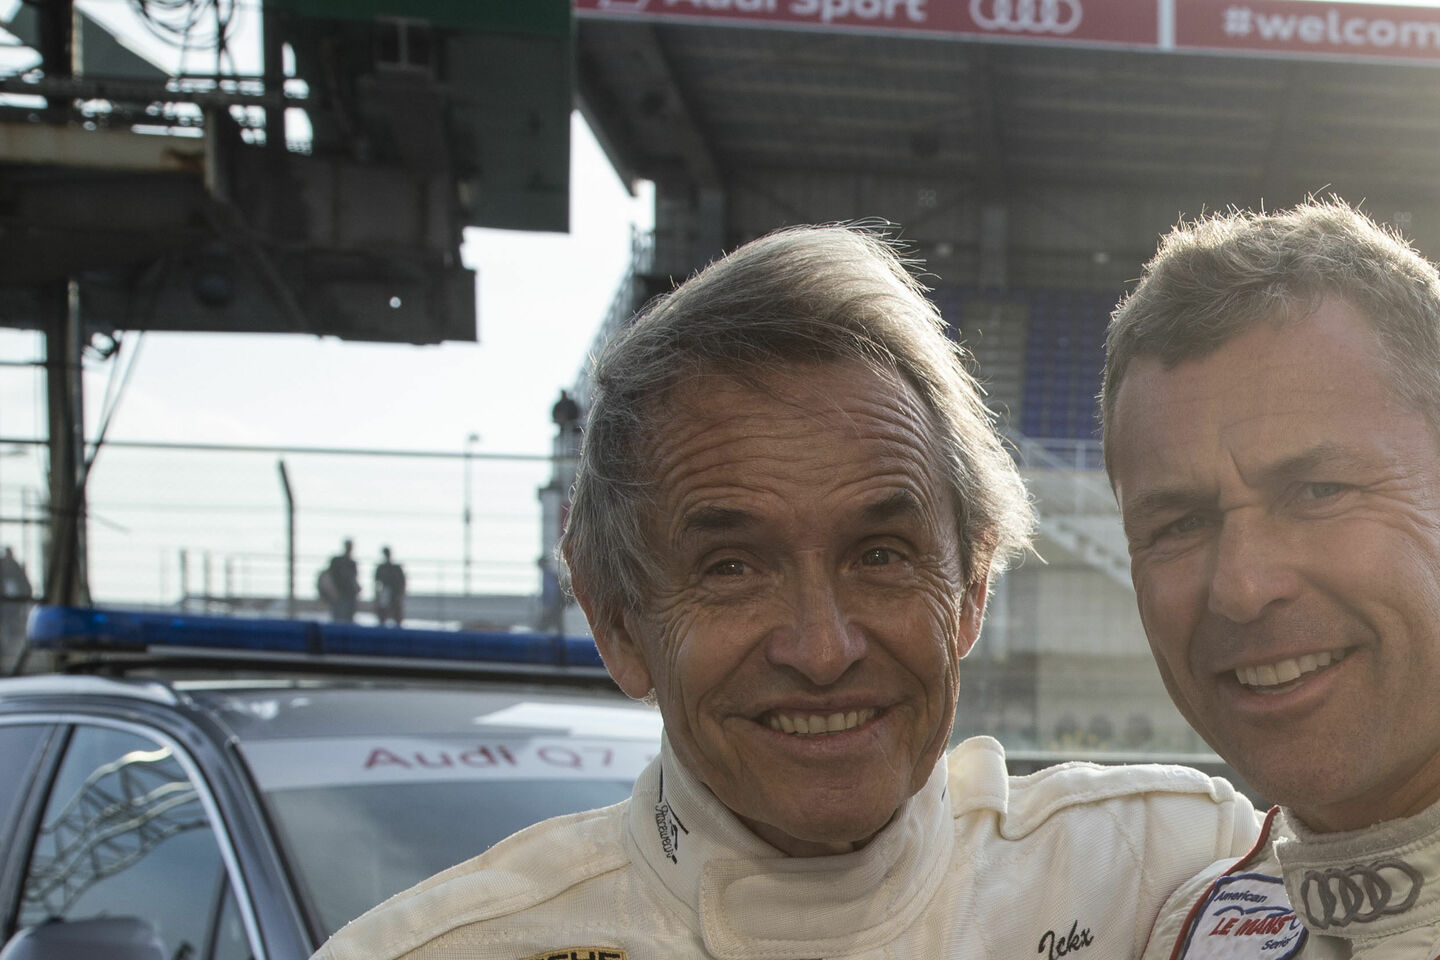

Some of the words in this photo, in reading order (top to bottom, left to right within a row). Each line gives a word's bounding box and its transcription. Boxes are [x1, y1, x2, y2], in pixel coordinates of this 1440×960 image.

[364, 744, 518, 770] Audi
[536, 745, 614, 771] Q7
[1214, 890, 1268, 903] American
[1208, 917, 1240, 936] LE
[1234, 915, 1296, 936] MANS
